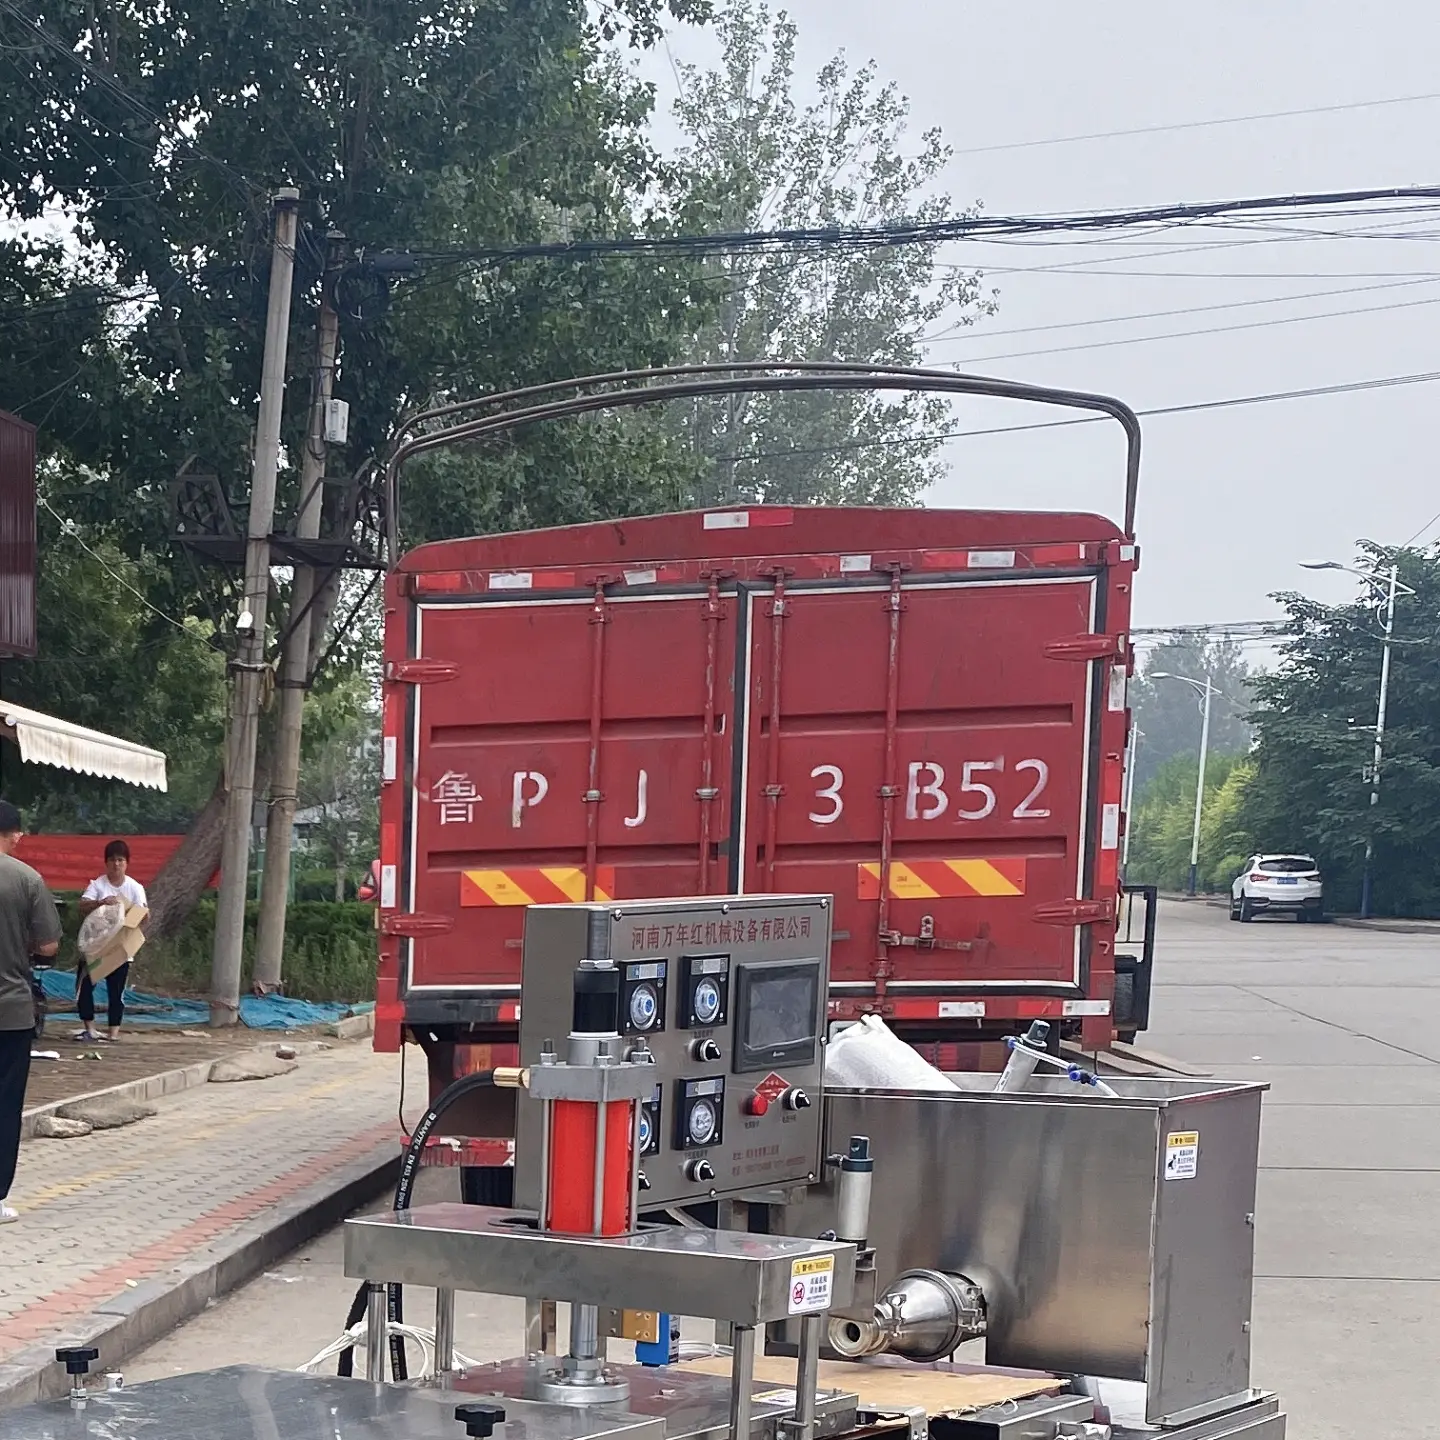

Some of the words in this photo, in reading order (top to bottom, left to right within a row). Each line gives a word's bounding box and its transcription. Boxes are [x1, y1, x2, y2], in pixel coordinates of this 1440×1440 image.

[432, 770, 483, 825] 鲁
[905, 758, 1051, 820] B52
[631, 916, 811, 950] 河南万年红机械设备有限公司
